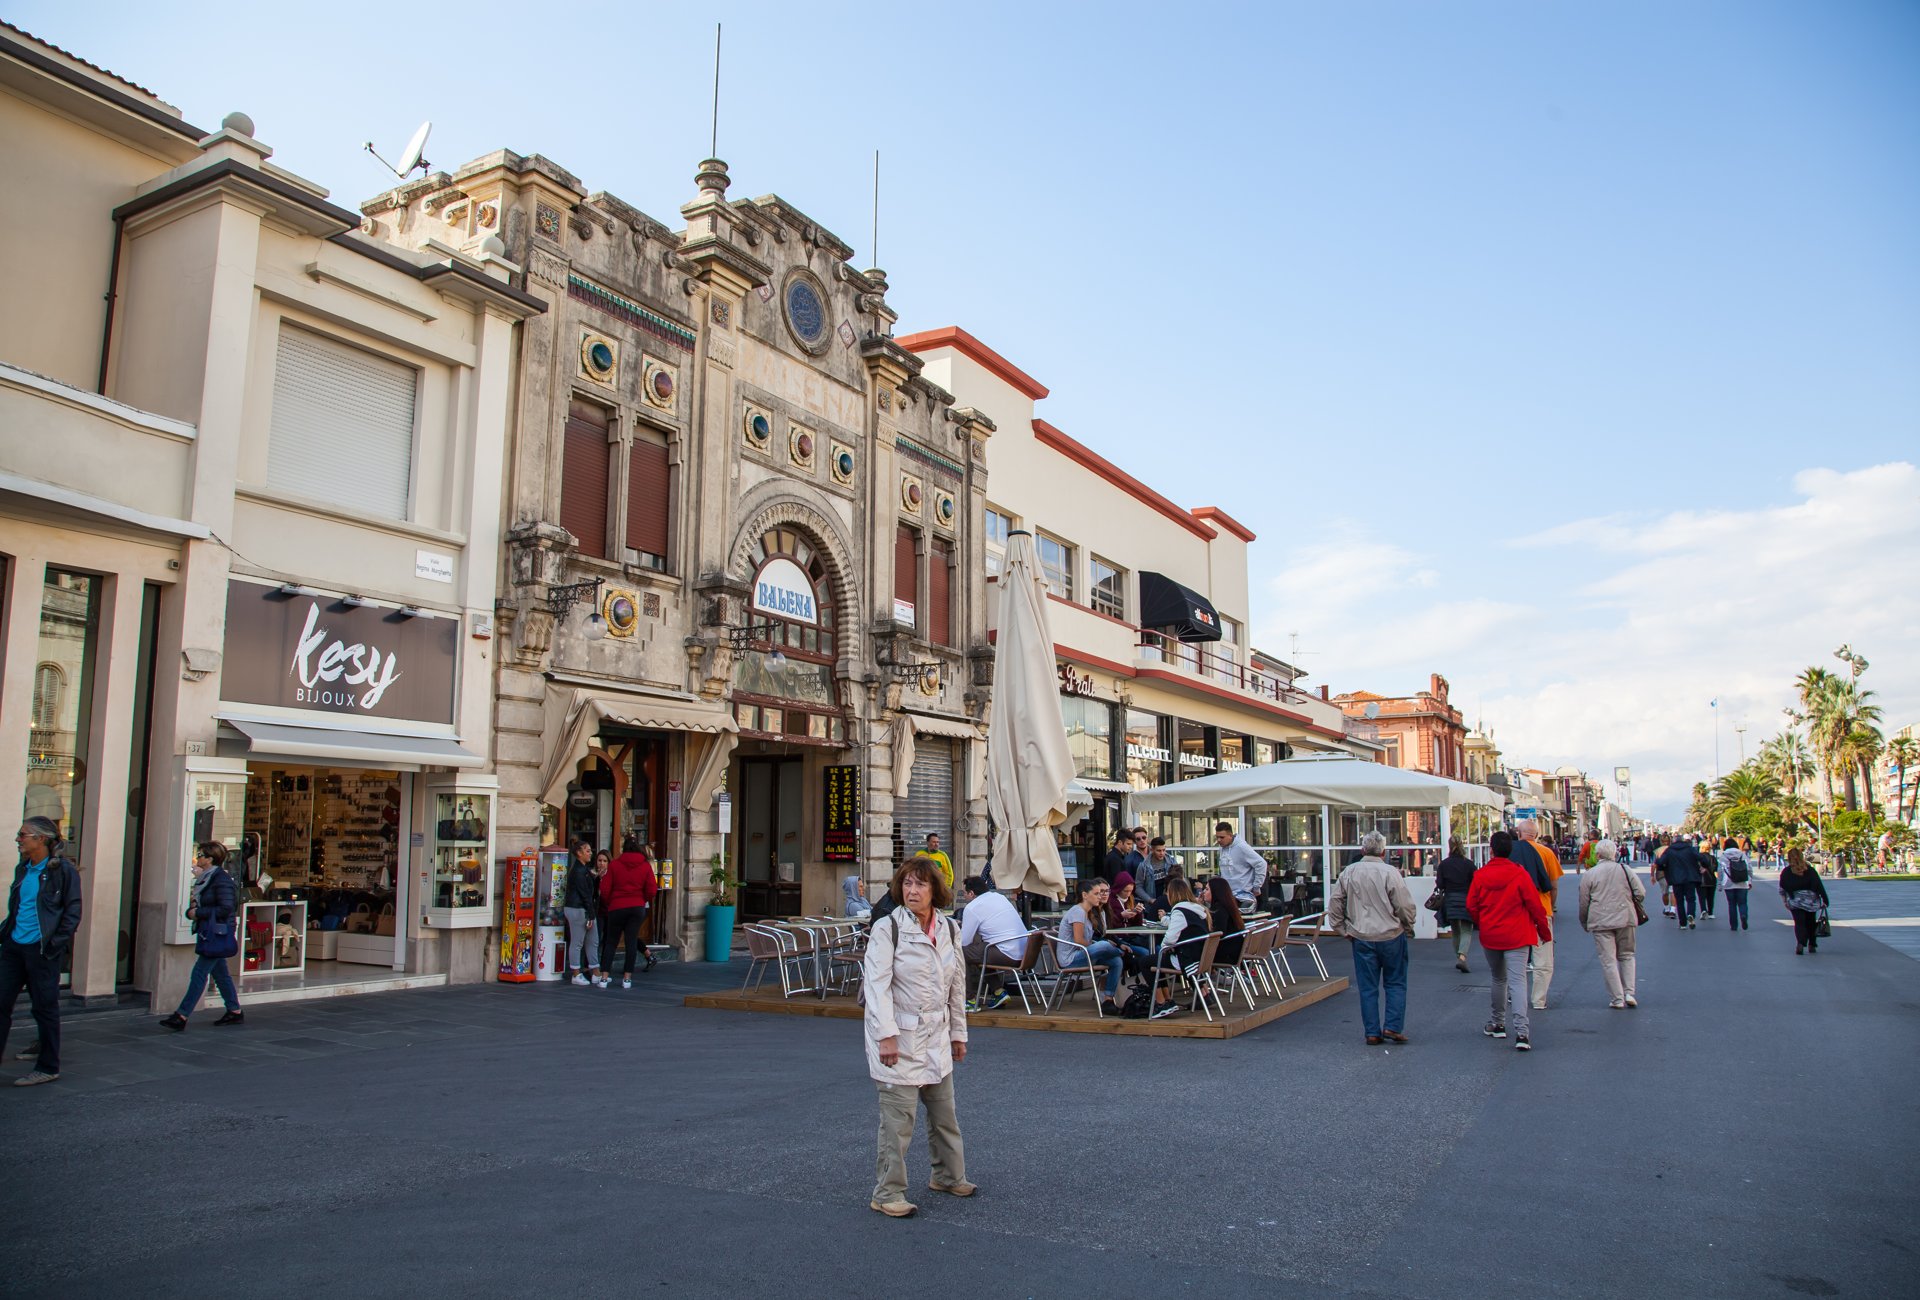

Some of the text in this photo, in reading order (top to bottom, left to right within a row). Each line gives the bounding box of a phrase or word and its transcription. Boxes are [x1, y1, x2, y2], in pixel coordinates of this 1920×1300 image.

[758, 582, 813, 619] BALENA
[296, 688, 356, 708] BIJOUX
[1126, 743, 1170, 761] ALCOTT
[1179, 752, 1216, 768] ALCOTT
[829, 767, 839, 830] RISTORANTE
[842, 767, 852, 825] PIZZERIA
[825, 844, 854, 853] da Aldo
